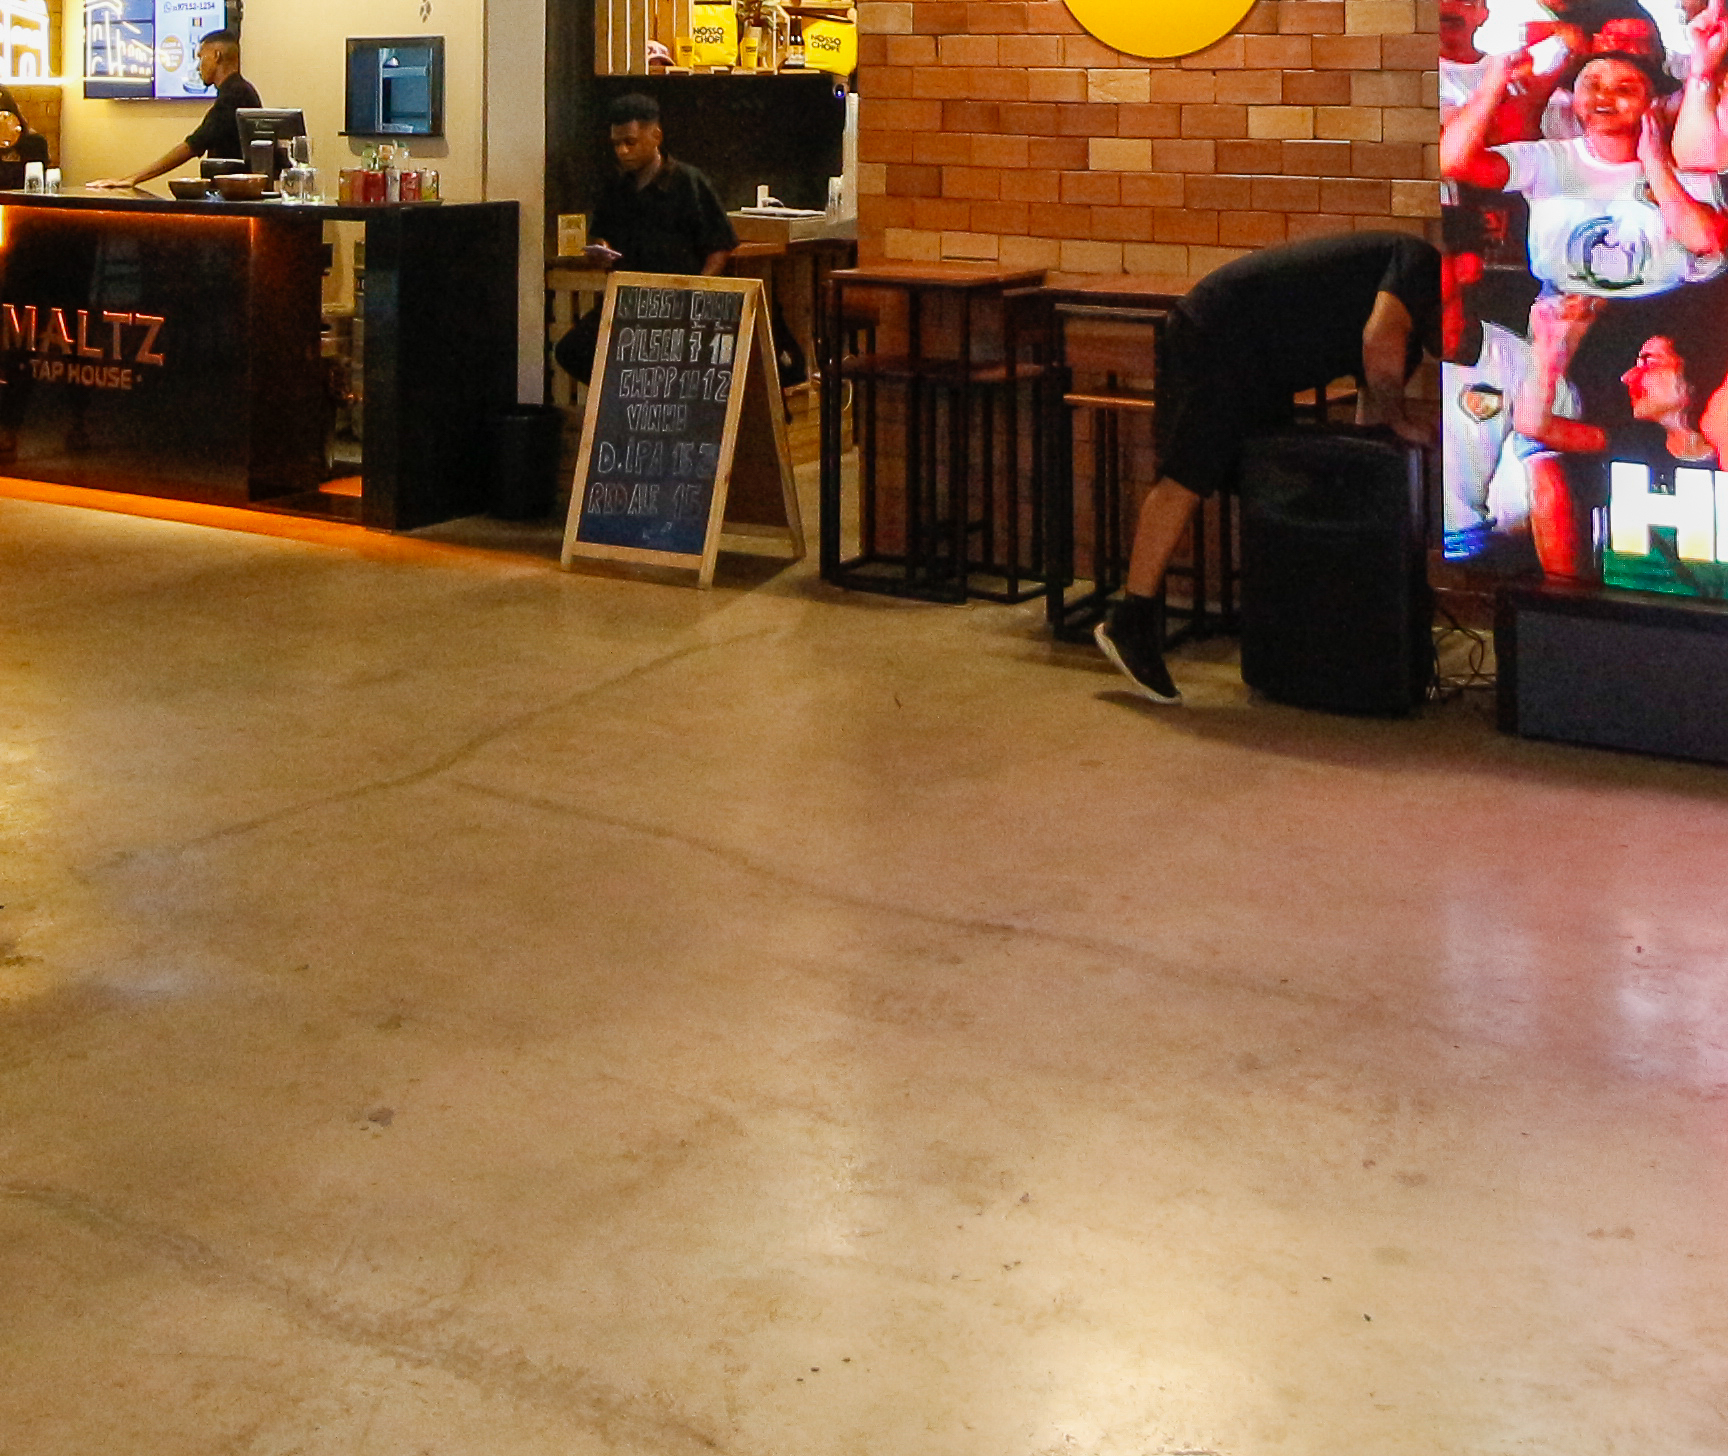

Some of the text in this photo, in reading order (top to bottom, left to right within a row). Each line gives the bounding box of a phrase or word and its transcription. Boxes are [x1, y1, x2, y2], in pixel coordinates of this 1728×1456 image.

[692, 26, 725, 36] NOSSO
[810, 33, 842, 45] NOSSO
[1, 302, 166, 367] MALTZ
[29, 358, 133, 391] TAP HOUSE
[702, 367, 732, 403] 12
